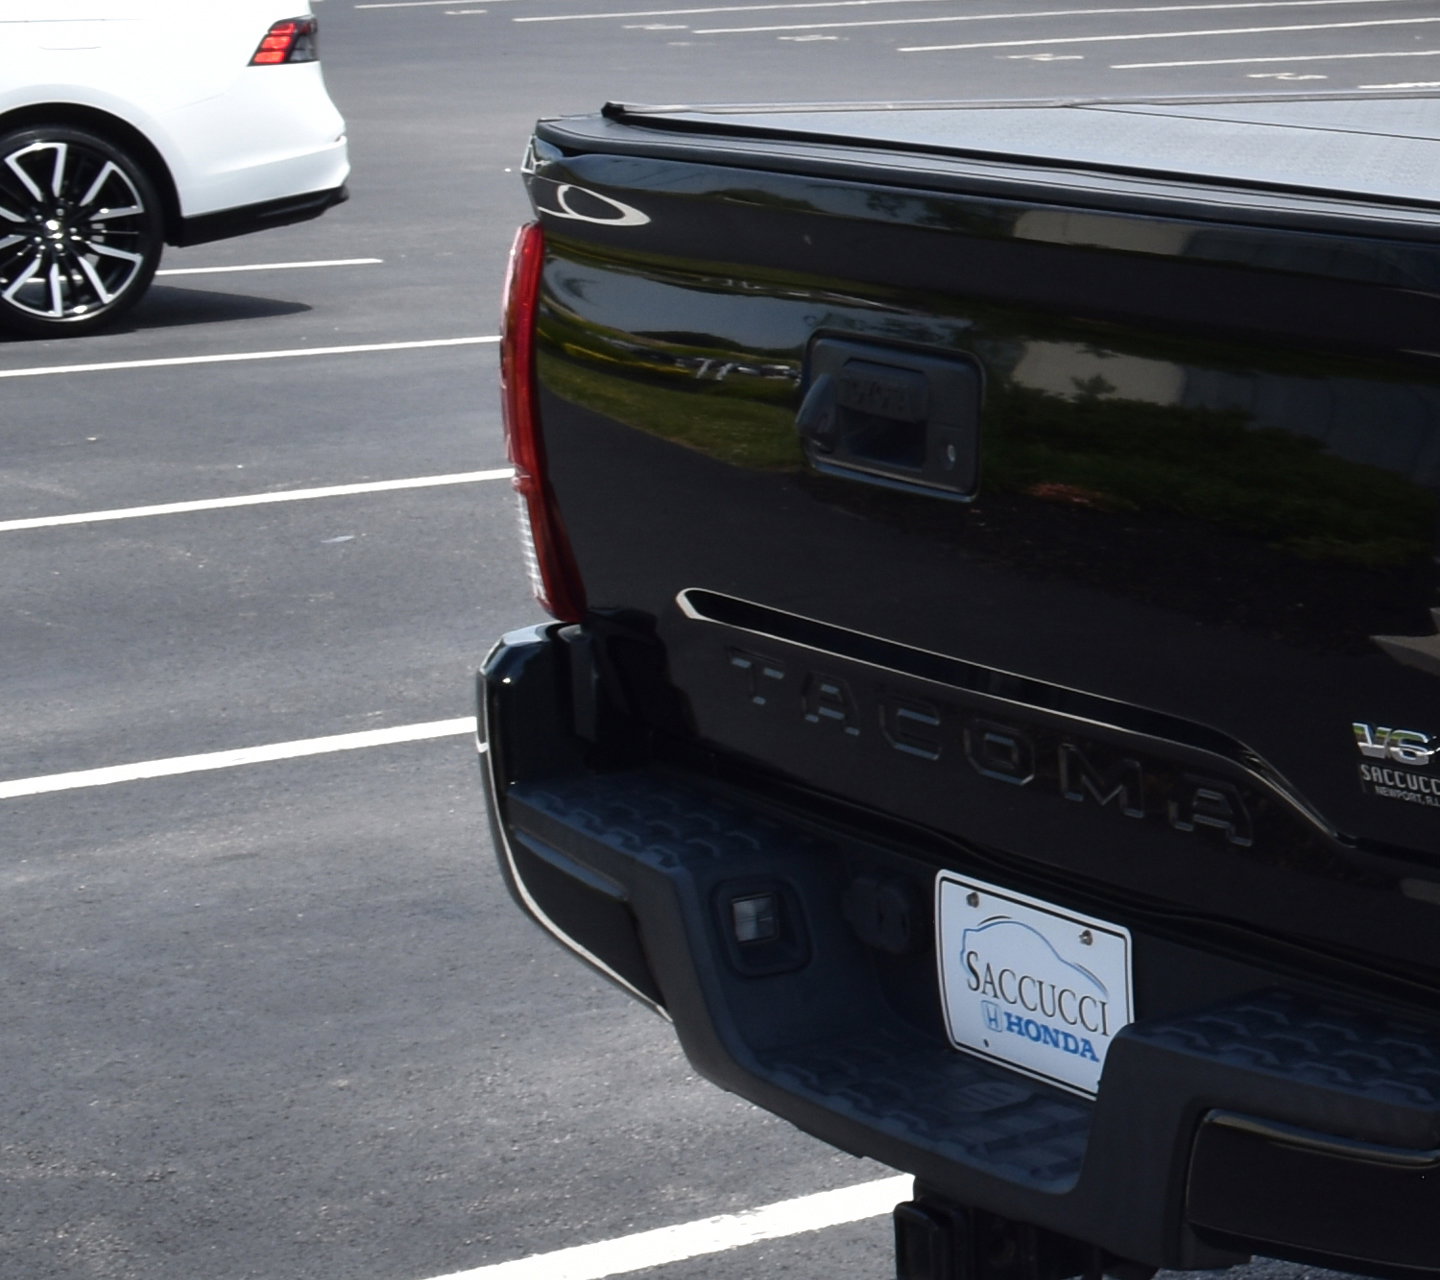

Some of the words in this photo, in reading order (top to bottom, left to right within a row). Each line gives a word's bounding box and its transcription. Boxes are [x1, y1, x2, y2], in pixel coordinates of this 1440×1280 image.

[726, 645, 1254, 847] TACOMA
[1352, 722, 1440, 766] V6
[966, 950, 1111, 1037] SACCUCCI
[1003, 1011, 1100, 1063] HONDA
